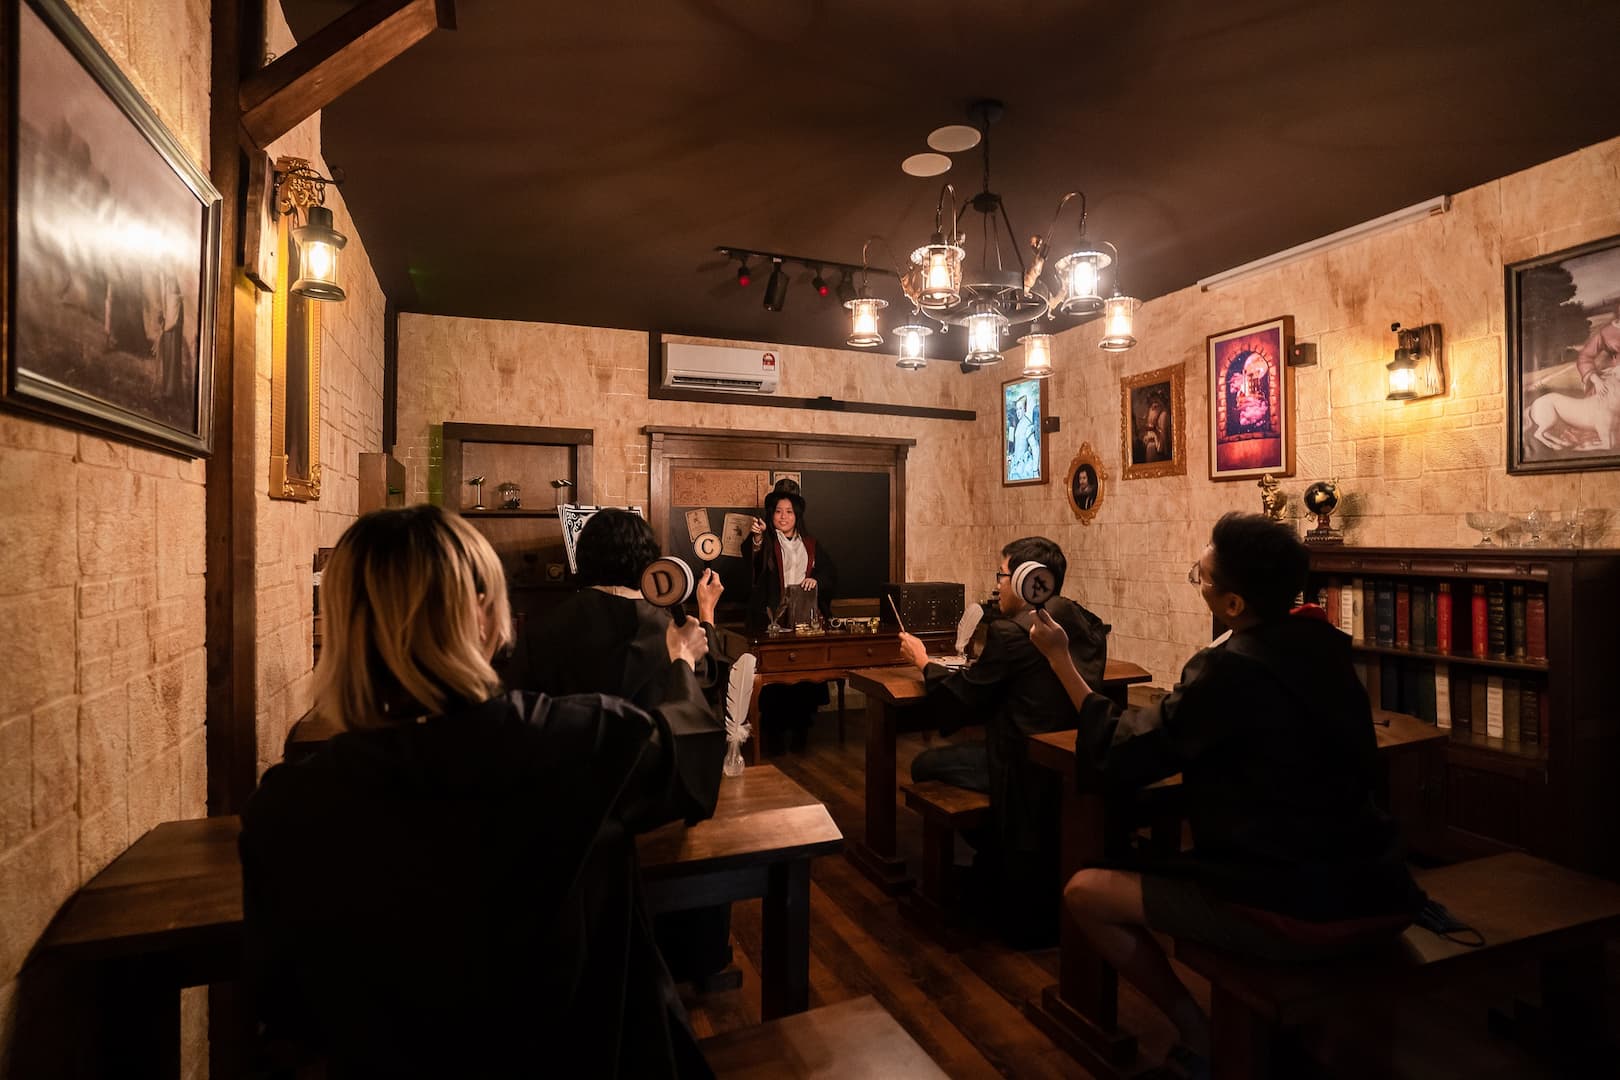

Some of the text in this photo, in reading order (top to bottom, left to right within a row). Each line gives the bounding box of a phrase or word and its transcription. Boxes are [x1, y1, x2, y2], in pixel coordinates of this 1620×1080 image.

[701, 538, 714, 555] C
[651, 570, 673, 598] D
[1031, 576, 1049, 599] A
